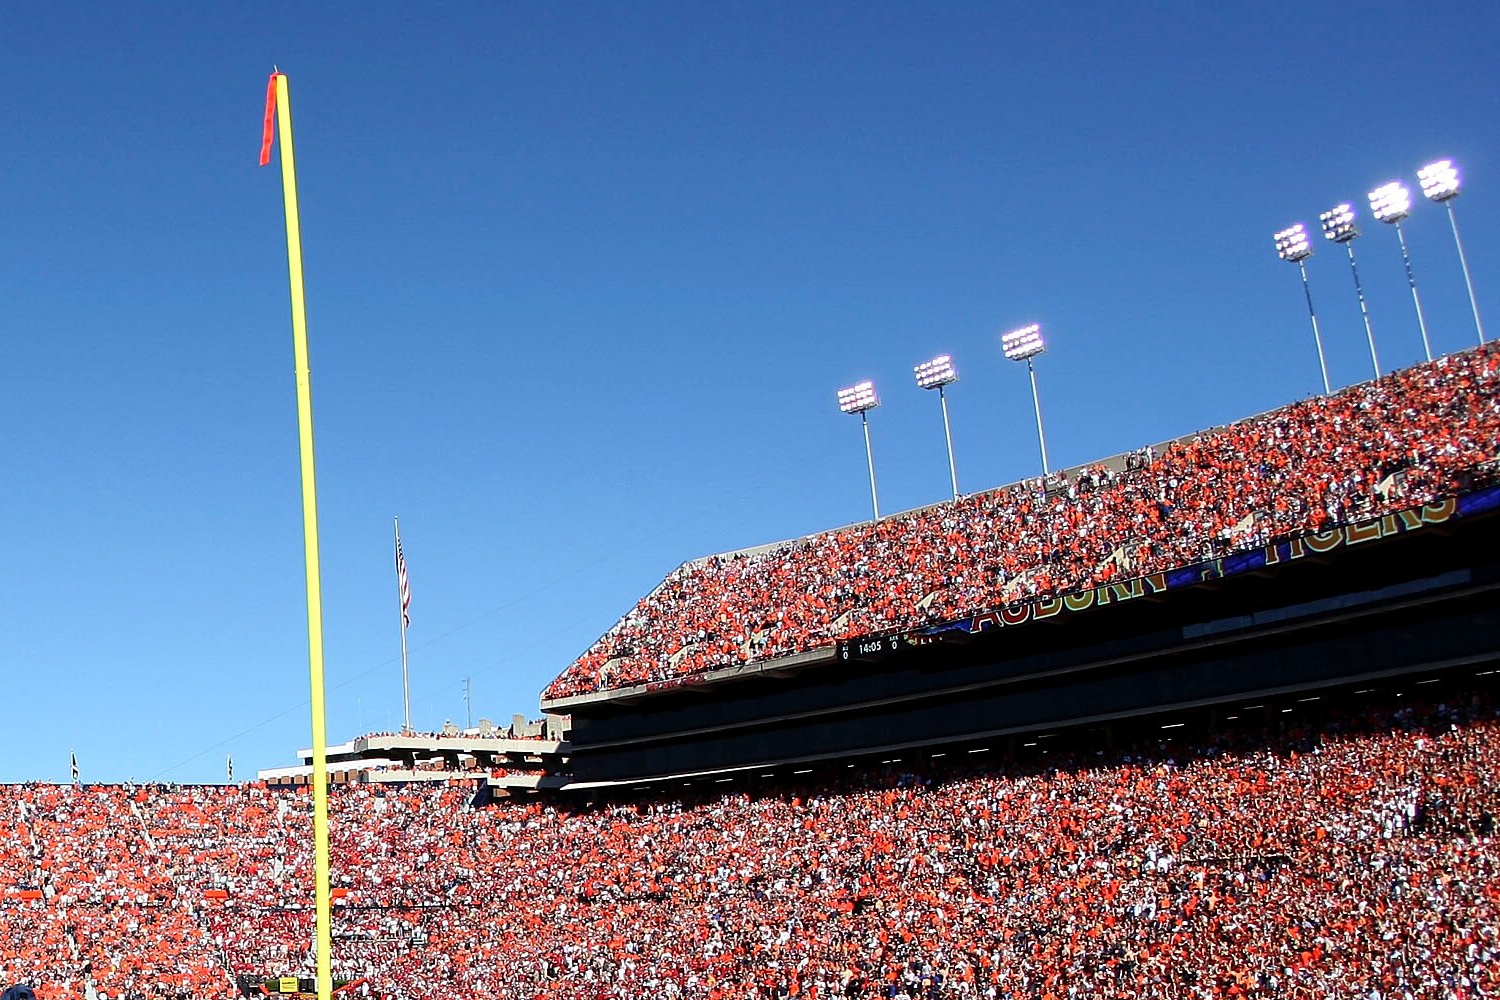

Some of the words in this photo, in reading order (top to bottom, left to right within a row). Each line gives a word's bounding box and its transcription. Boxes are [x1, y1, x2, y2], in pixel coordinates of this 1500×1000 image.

[859, 641, 882, 654] 14:05
[891, 641, 898, 650] 0
[843, 651, 849, 660] 0
